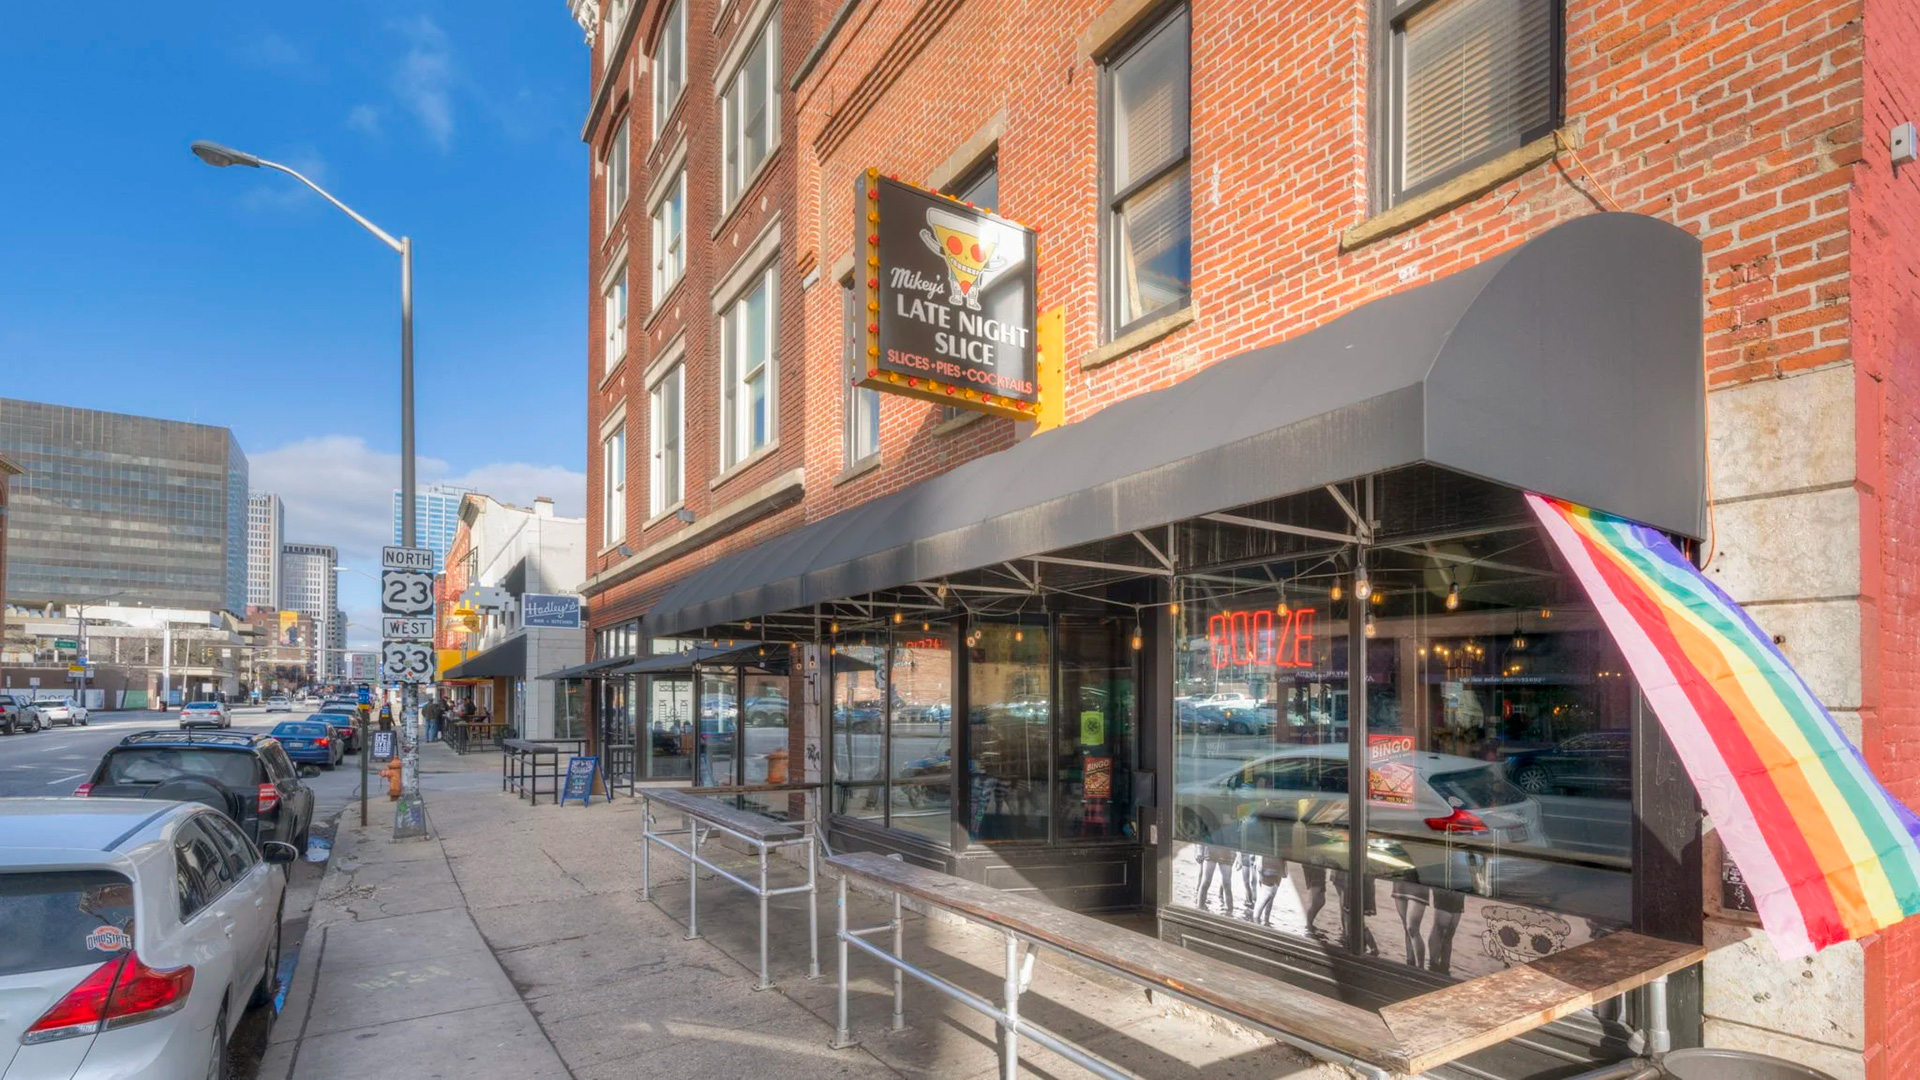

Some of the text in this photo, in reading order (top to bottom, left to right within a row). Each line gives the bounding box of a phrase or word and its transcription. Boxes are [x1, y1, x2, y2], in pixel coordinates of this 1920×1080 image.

[890, 266, 945, 300] Mikey's
[897, 293, 1029, 348] LATE NIGHT
[934, 332, 995, 366] SLICE
[887, 349, 1033, 395] SLICES PIES COCKTAILS
[385, 551, 431, 566] NORTH
[389, 580, 428, 604] 23
[525, 599, 577, 619] Hadley's
[390, 622, 427, 634] WEST
[1209, 608, 1316, 668] BOOZE
[389, 650, 429, 674] 33
[375, 732, 392, 741] GET
[1372, 738, 1412, 759] BINGO
[1086, 759, 1110, 771] BINGO
[87, 932, 131, 949] OHIO STATE
